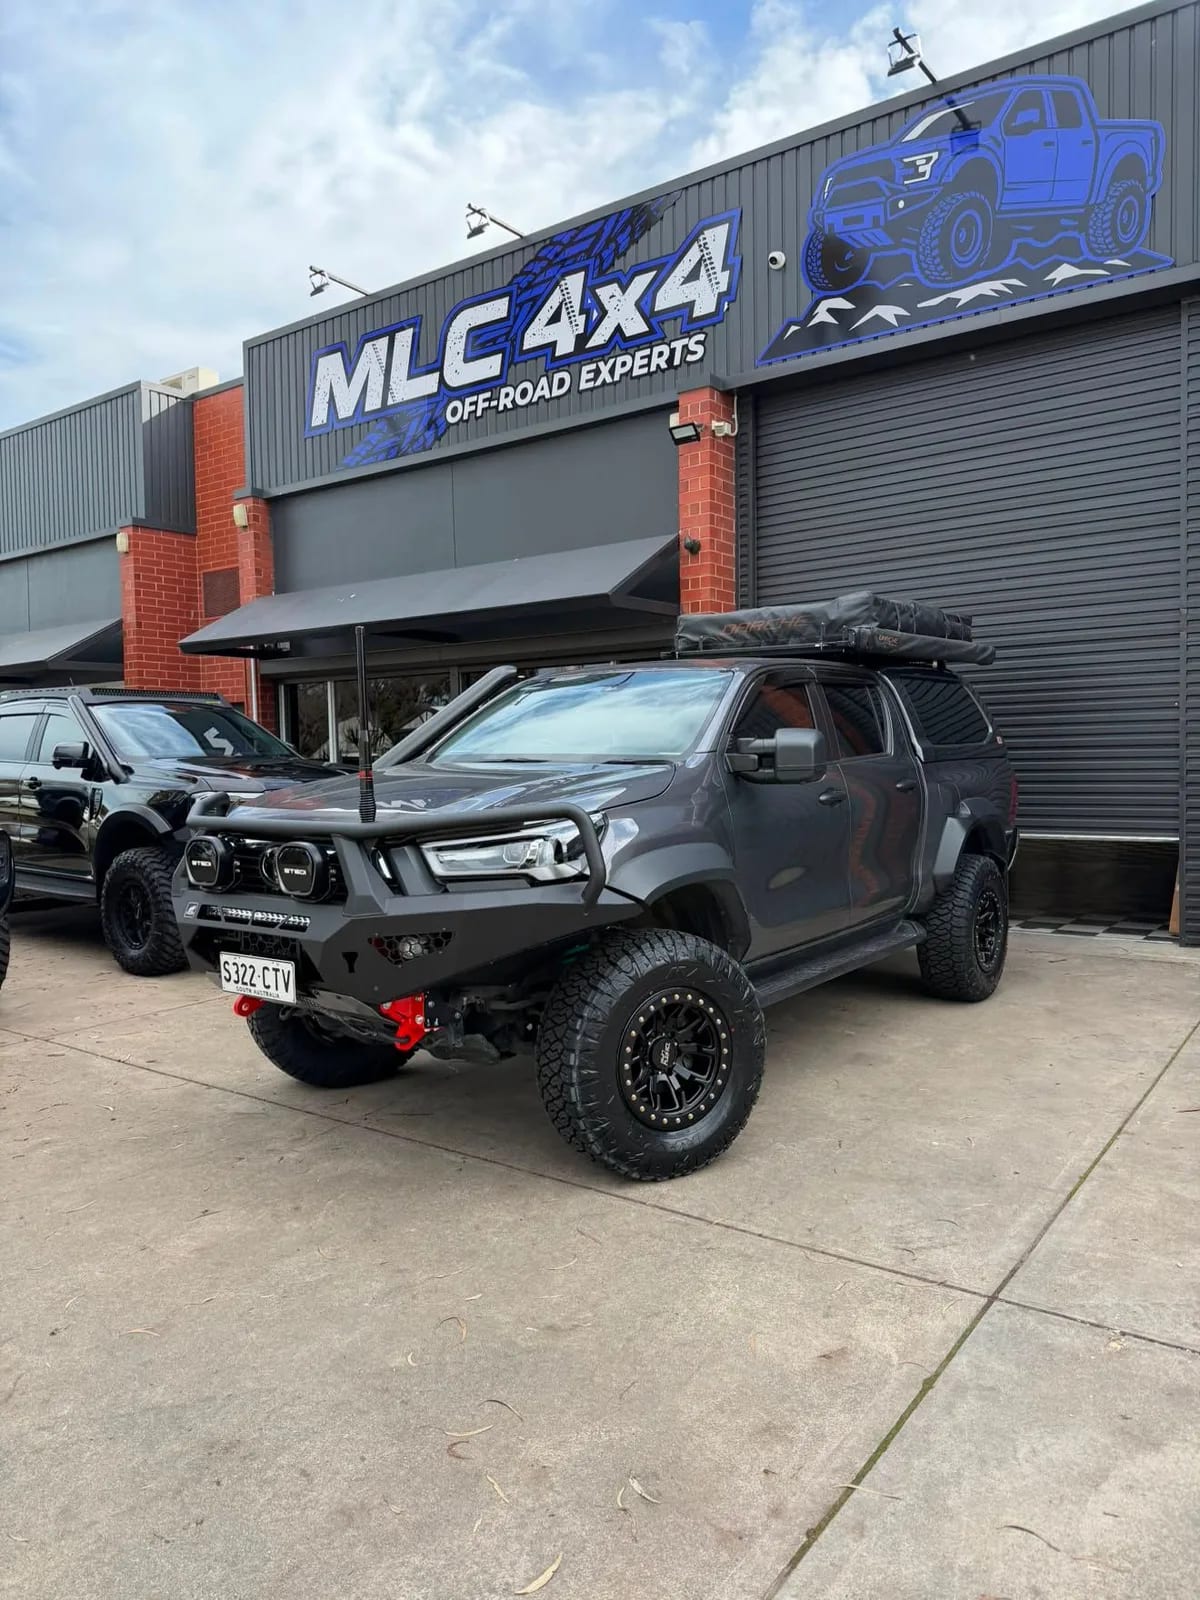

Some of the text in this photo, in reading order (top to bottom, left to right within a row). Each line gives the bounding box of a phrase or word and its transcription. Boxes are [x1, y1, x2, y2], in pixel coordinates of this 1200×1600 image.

[310, 222, 731, 428] MLC 4x4
[445, 333, 706, 425] OFF-ROAD EXPERTS
[236, 985, 280, 999] SOUTH AUSTRALIA
